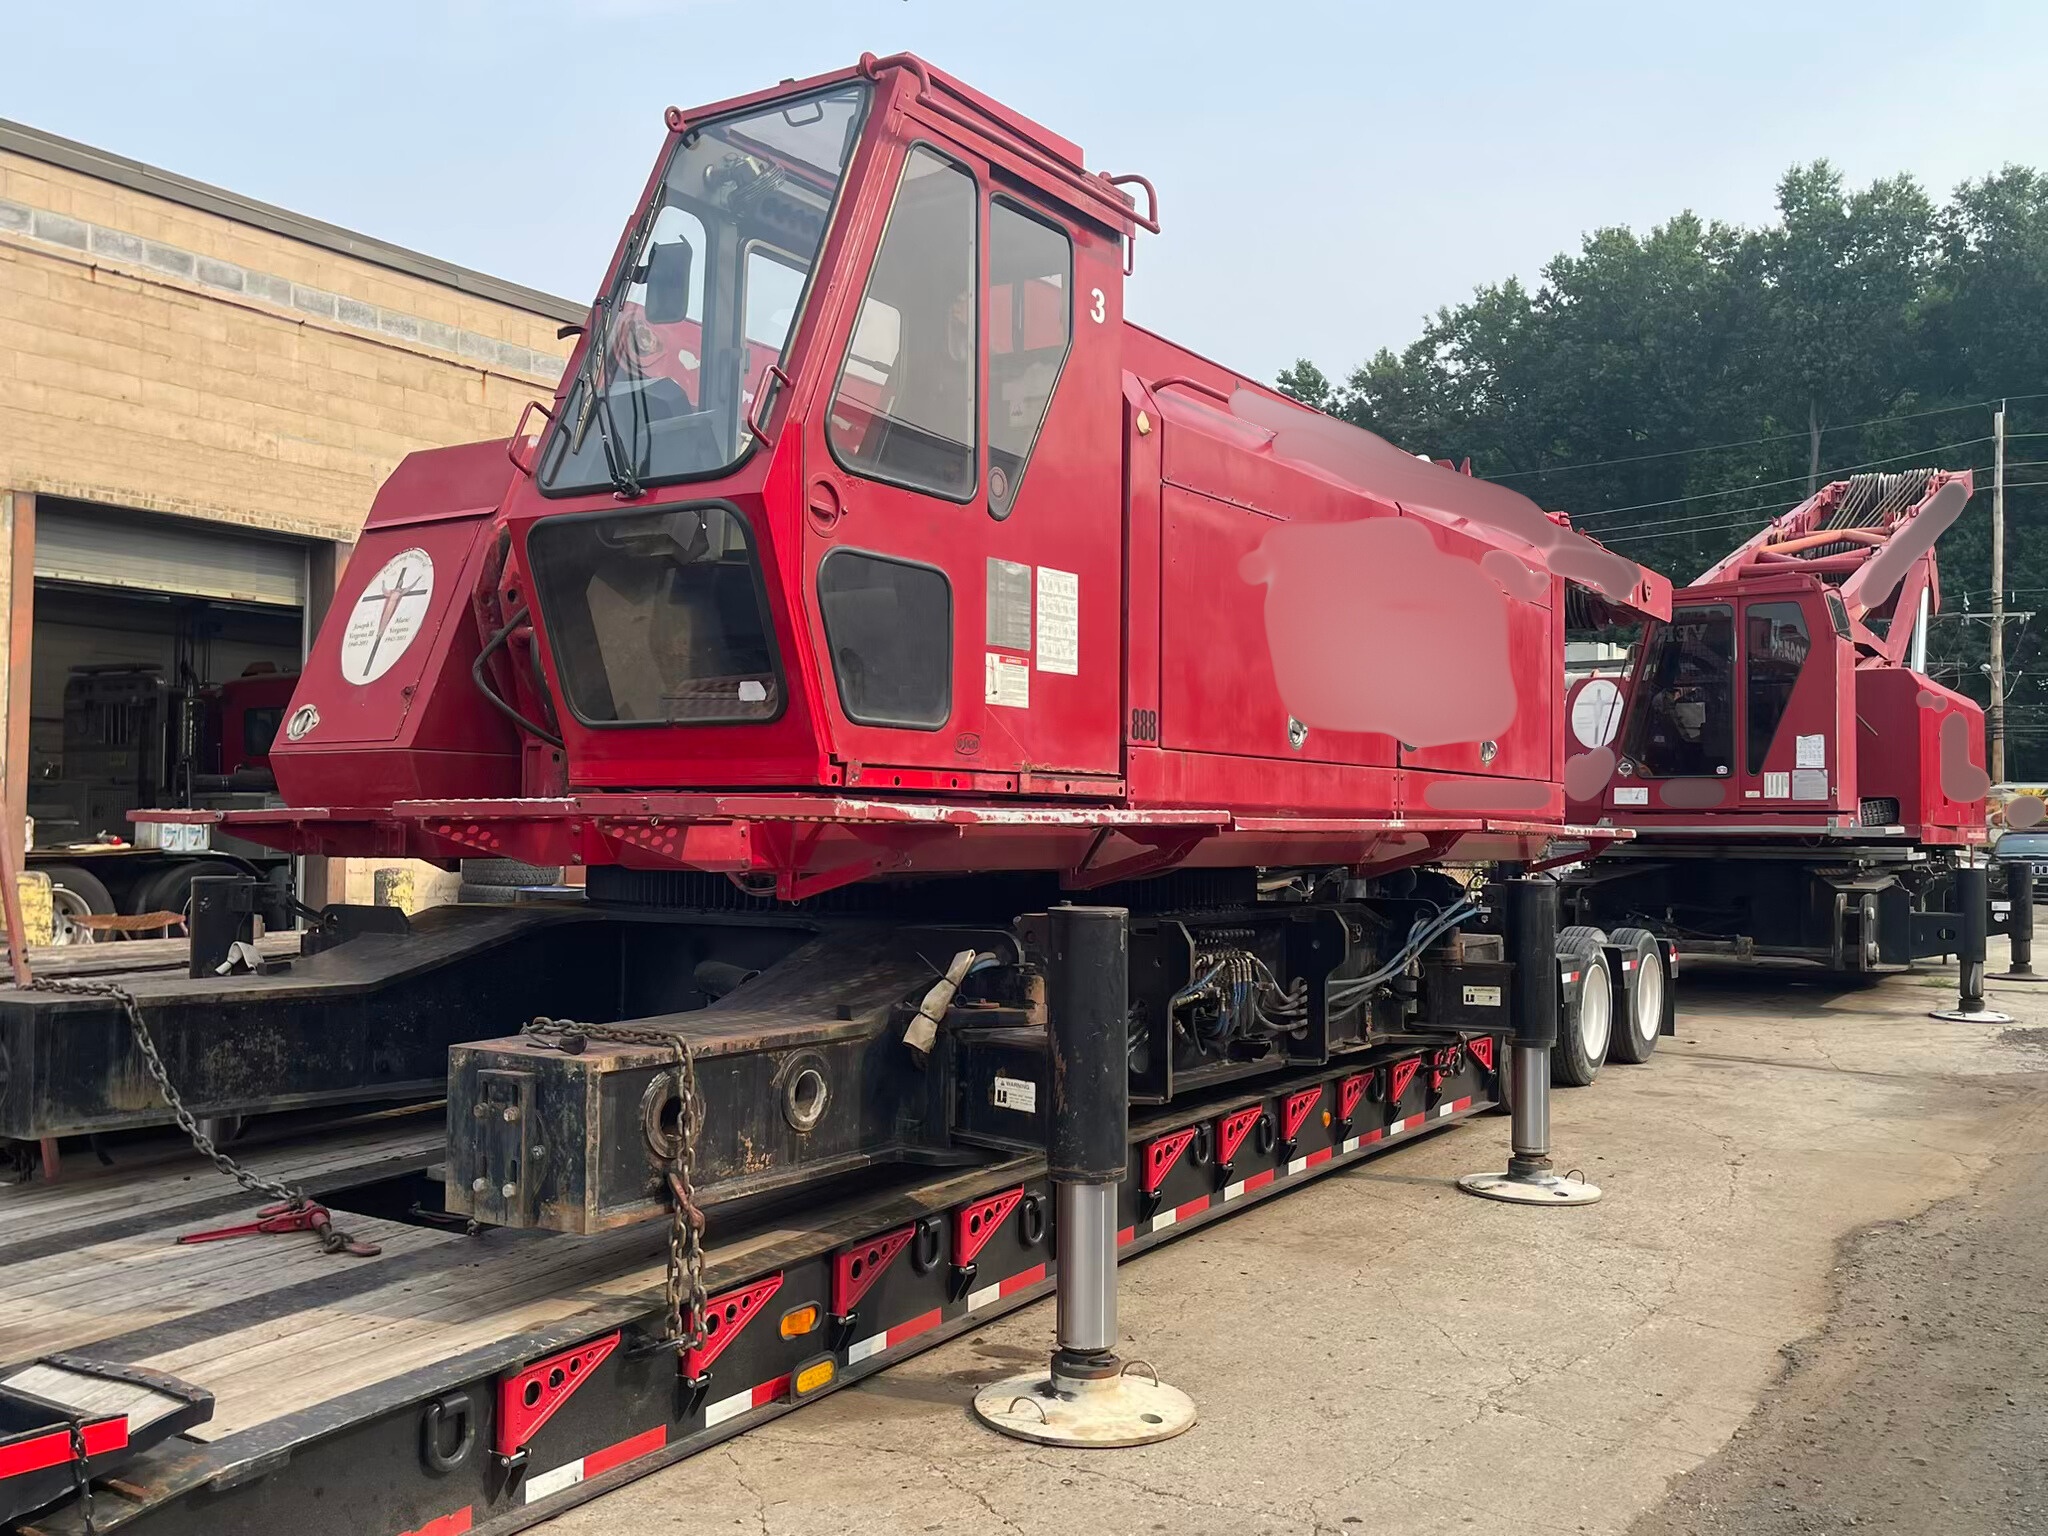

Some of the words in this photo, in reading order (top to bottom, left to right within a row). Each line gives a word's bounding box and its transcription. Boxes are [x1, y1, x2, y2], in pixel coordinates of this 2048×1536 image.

[1090, 287, 1106, 324] 3
[1132, 708, 1156, 742] 888
[1006, 1081, 1030, 1090] WARNING
